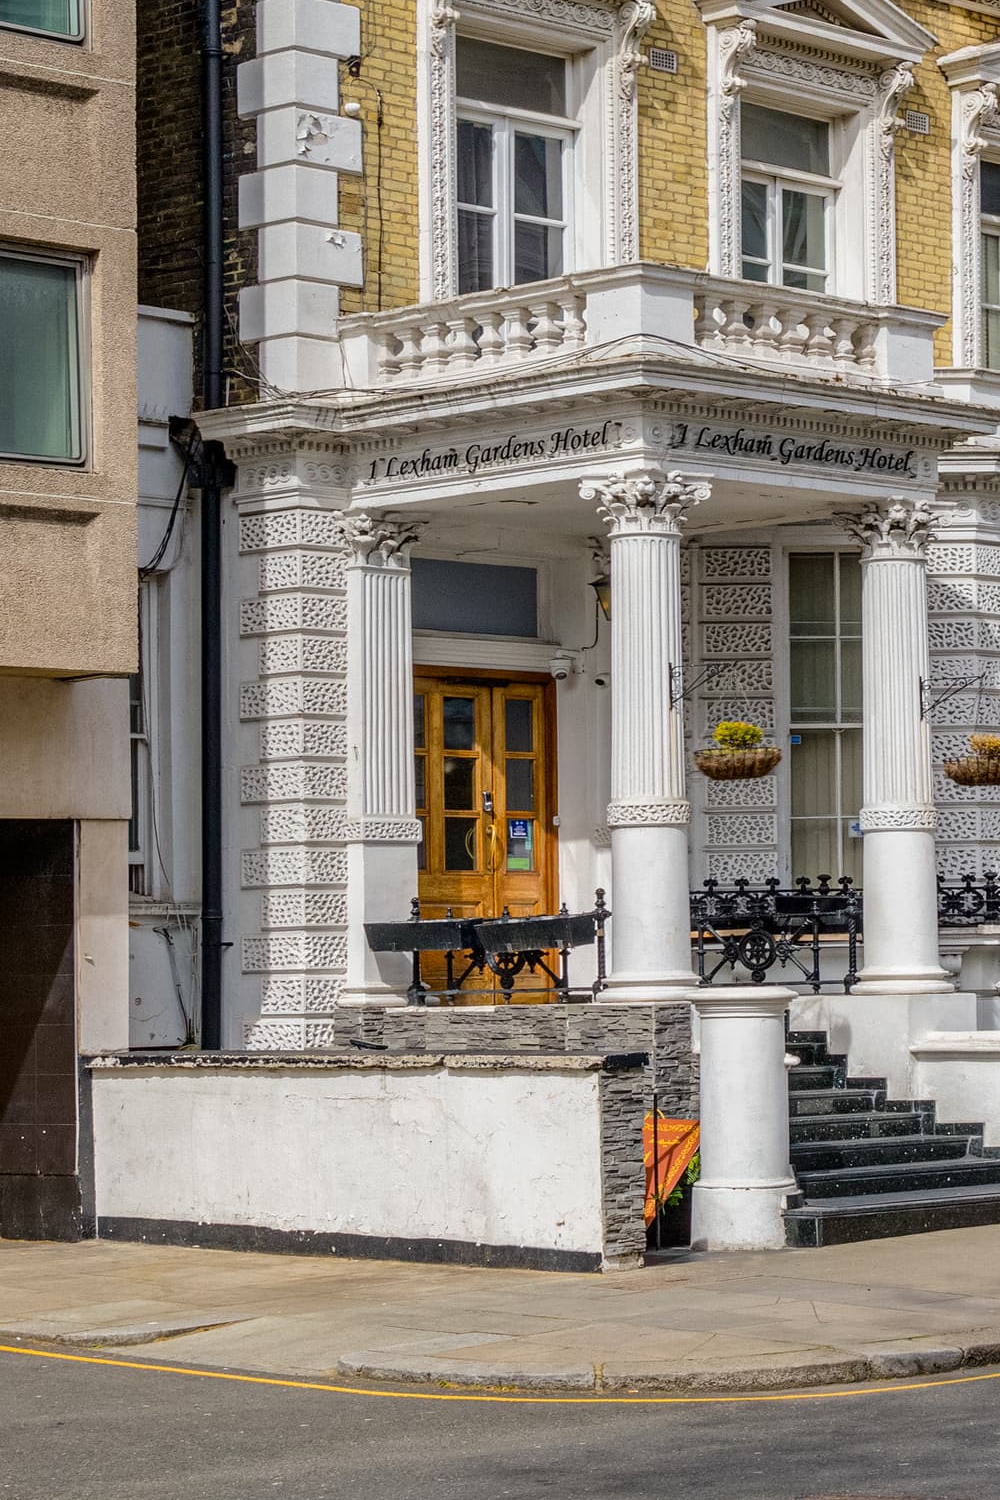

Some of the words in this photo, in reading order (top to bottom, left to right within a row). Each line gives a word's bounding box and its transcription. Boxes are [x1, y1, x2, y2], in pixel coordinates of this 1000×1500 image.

[384, 448, 458, 477] Lexham
[465, 435, 545, 474] Gardens
[550, 420, 612, 454] Hotel
[694, 427, 772, 455] Lexham
[780, 437, 855, 465] Gardens
[858, 447, 914, 472] Hotel
